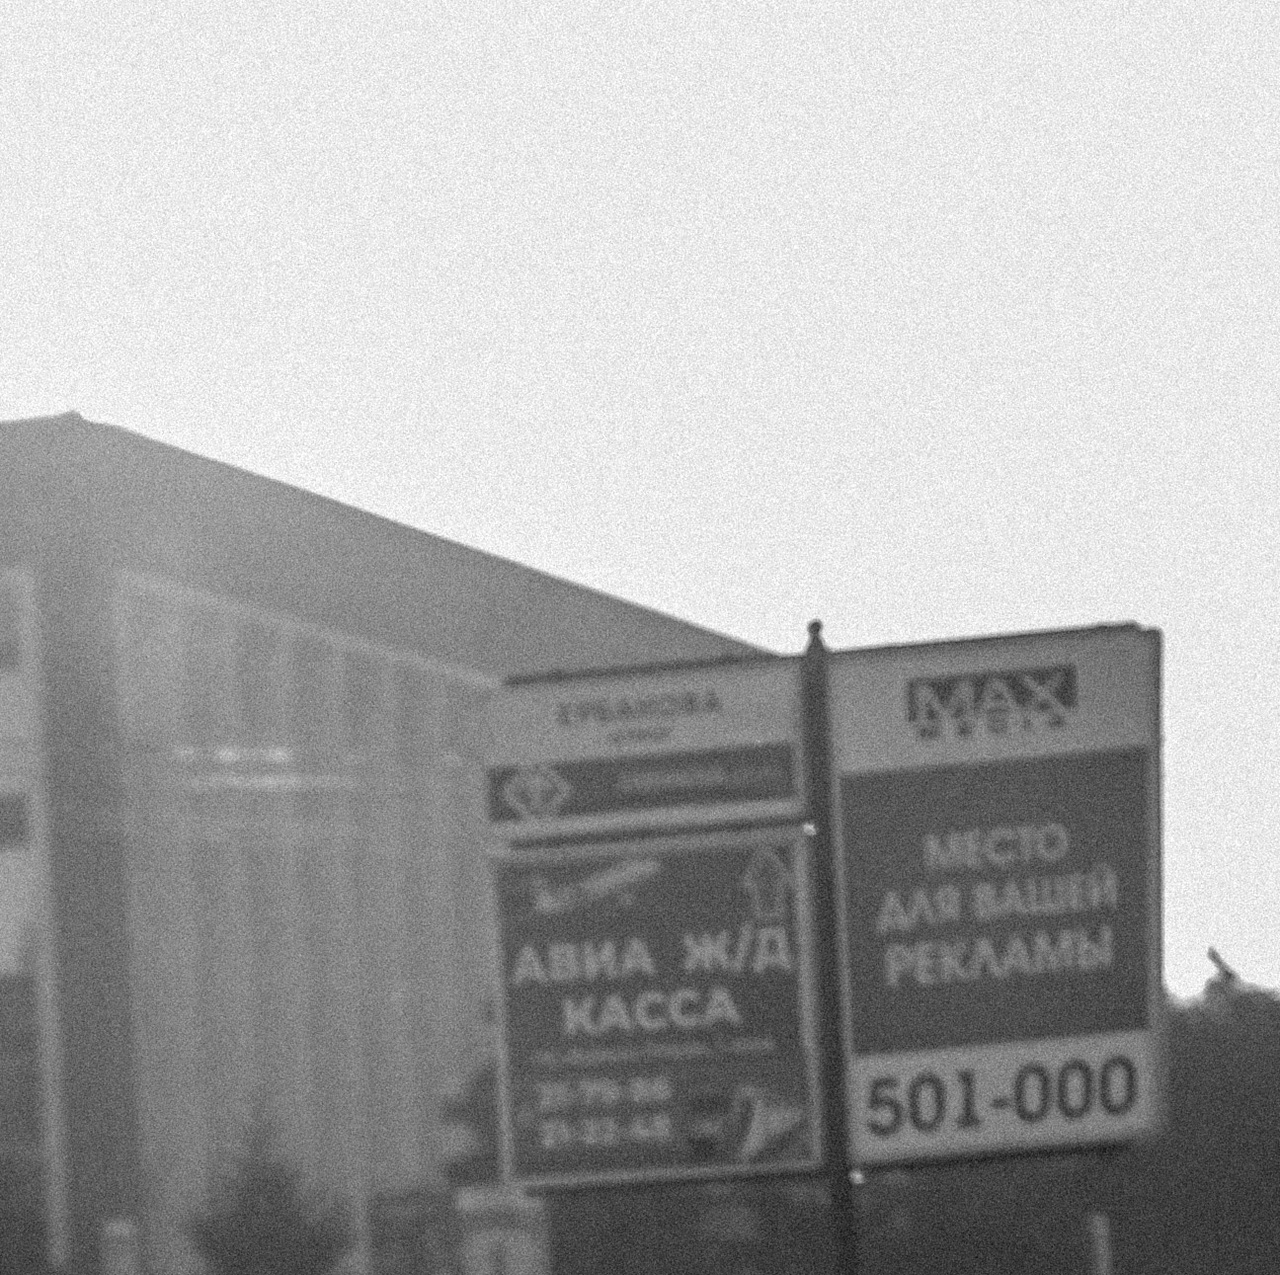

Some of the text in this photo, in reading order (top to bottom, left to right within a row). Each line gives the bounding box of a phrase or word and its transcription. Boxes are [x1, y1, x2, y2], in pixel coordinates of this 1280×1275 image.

[923, 821, 1070, 871] МЕСТО
[875, 861, 1118, 936] ДЛЯ ВАШЕЙ
[513, 921, 793, 986] АВИА Ж/Д
[884, 924, 1114, 989] РЕКЛАМЫ
[561, 986, 742, 1038] КАССА
[868, 1055, 1137, 1137] 501-000
